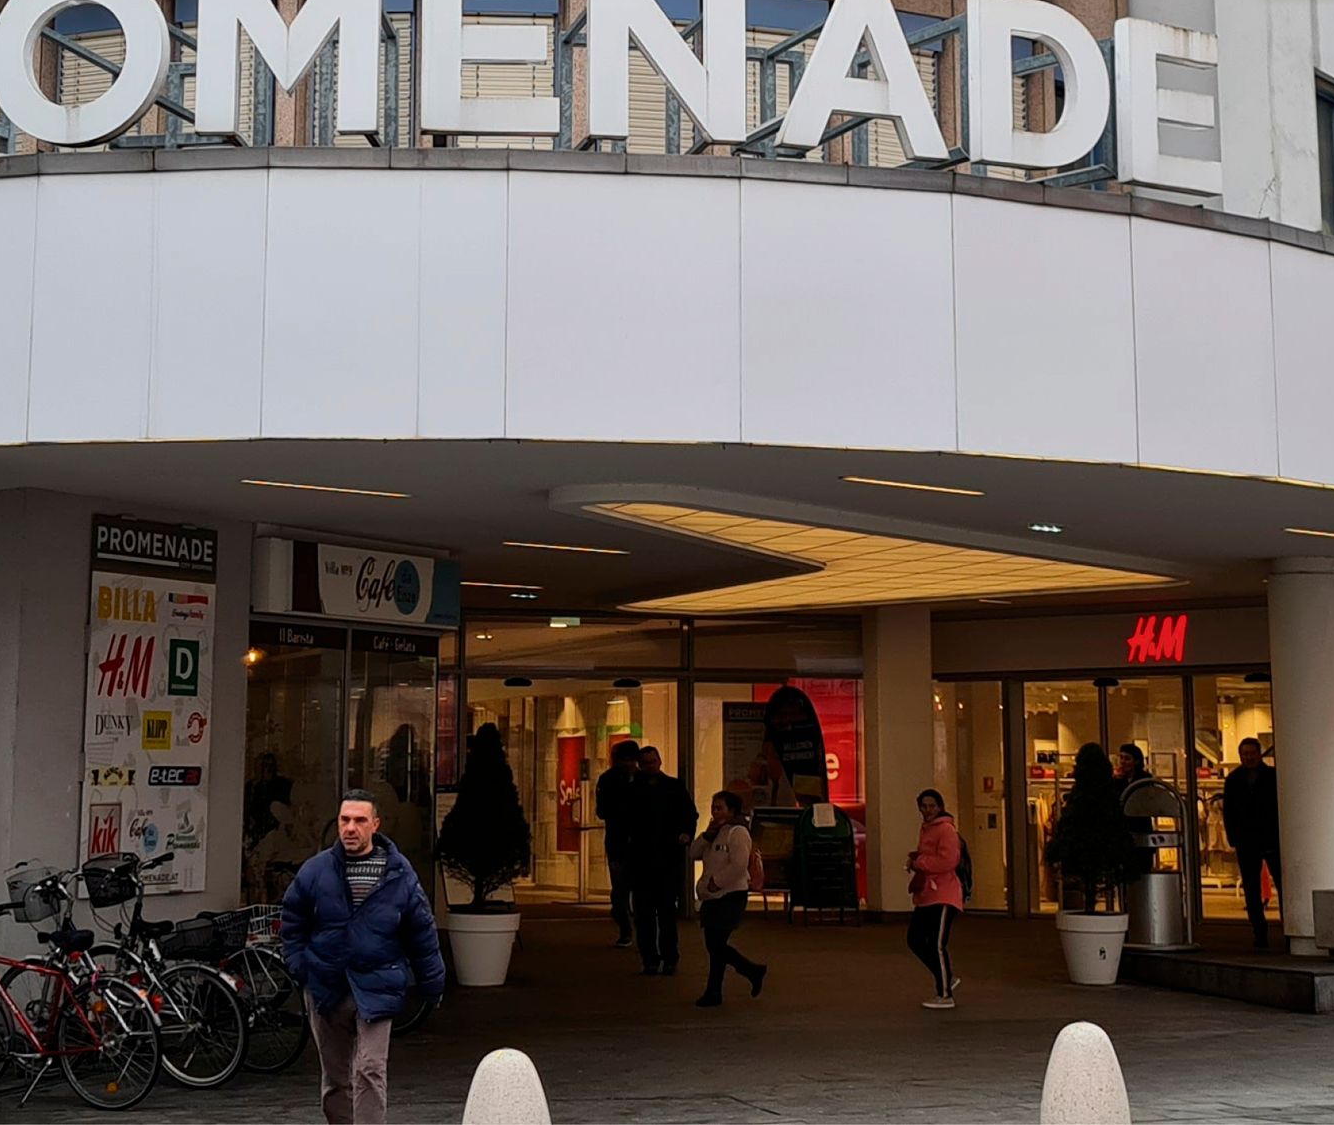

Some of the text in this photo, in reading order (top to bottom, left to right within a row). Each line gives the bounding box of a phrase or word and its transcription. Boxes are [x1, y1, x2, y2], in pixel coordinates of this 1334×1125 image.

[96, 525, 214, 563] PROMENADE
[98, 586, 156, 622] BILLA
[356, 556, 396, 612] Cafe
[1127, 615, 1187, 663] H&M
[98, 634, 155, 698] H&M
[175, 647, 194, 680] D
[95, 715, 132, 736] DUNKY
[91, 809, 117, 853] kik
